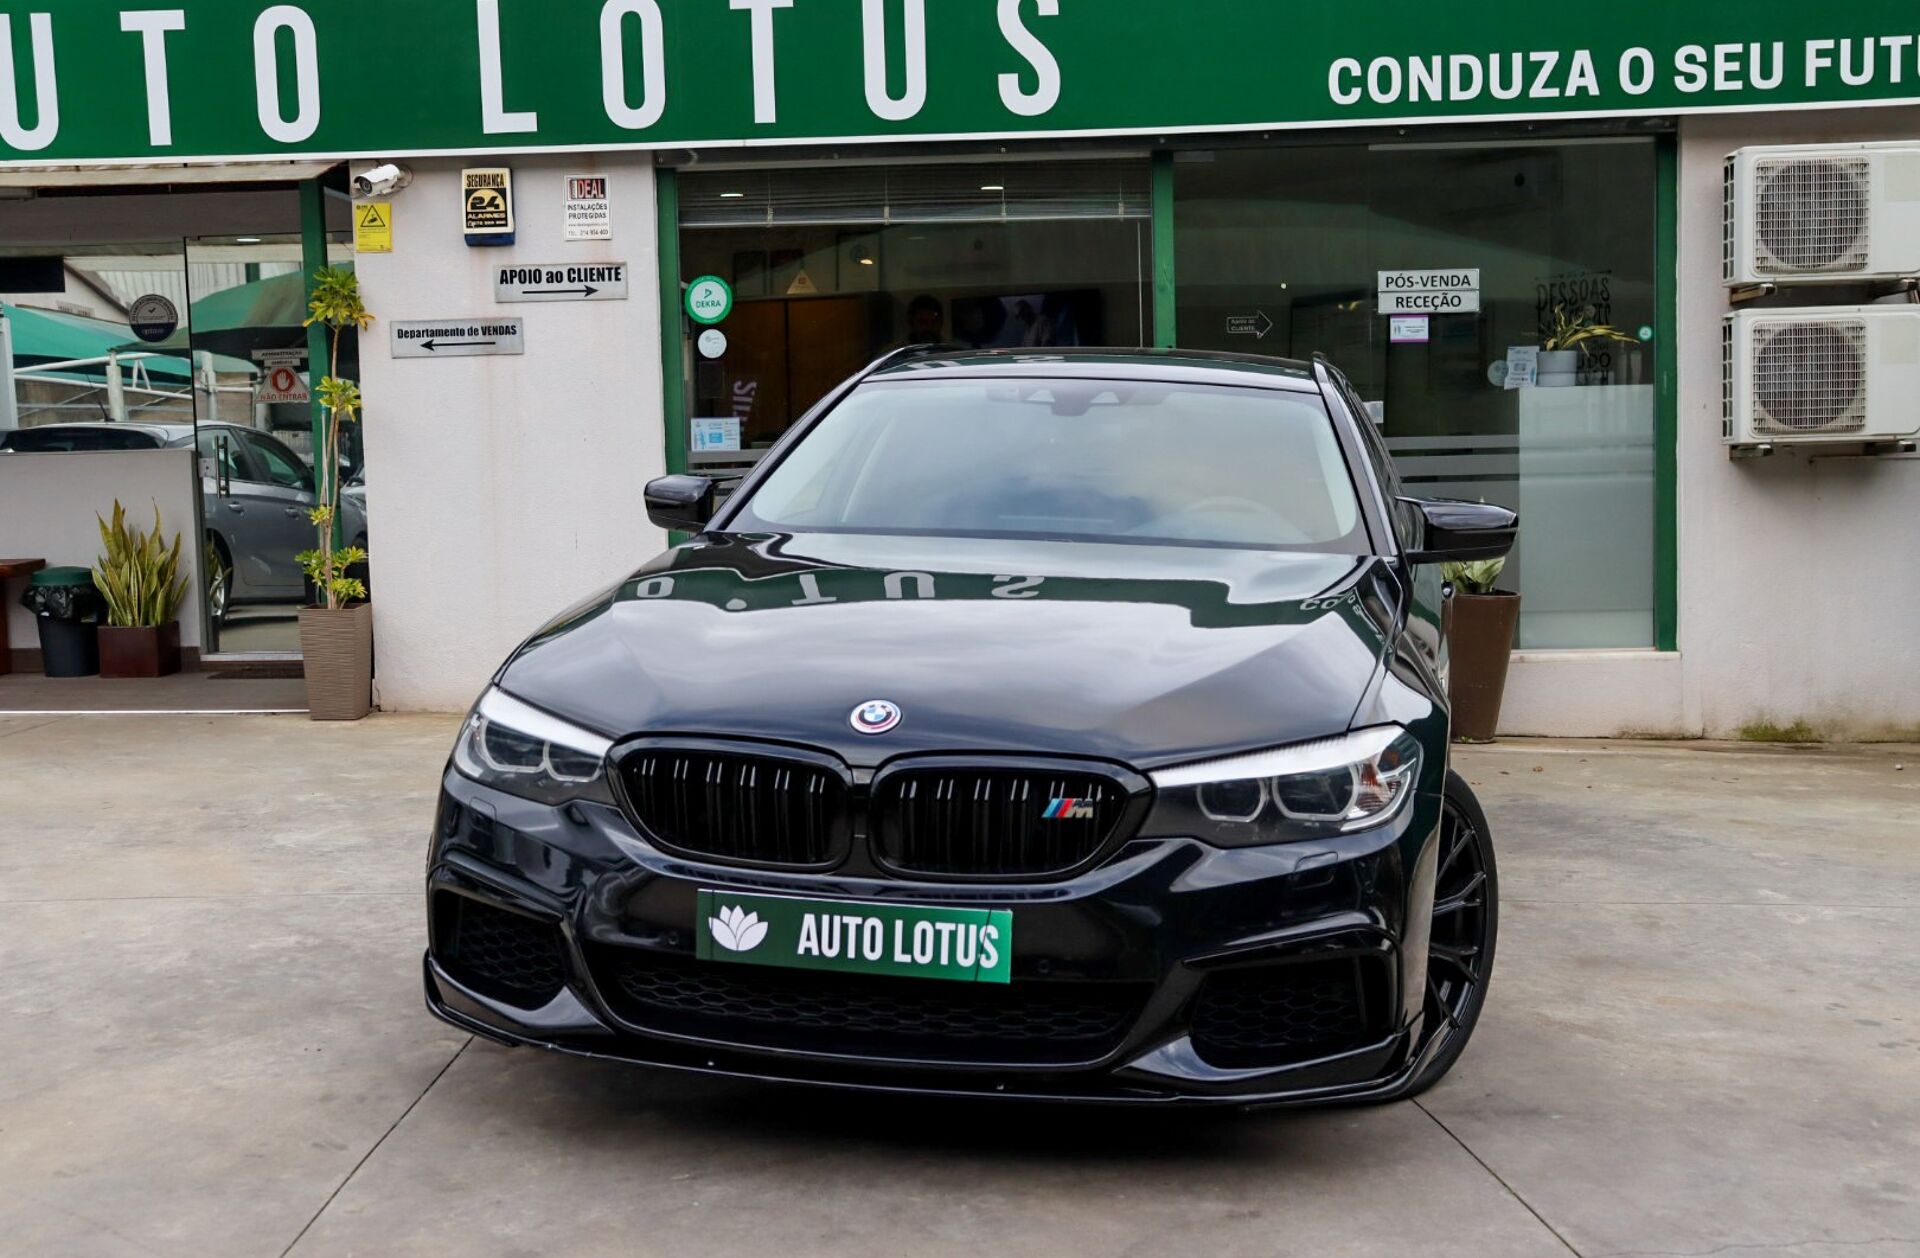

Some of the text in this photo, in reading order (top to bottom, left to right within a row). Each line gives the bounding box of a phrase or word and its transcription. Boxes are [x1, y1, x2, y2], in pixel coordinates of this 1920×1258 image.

[477, 0, 1061, 134] LOTUS
[1328, 35, 1920, 105] CONDUZA O SEU FUT
[467, 174, 504, 188] SEGURANÇA
[471, 196, 499, 210] 24
[568, 202, 607, 211] INSTALAÇÕES
[568, 212, 607, 220] PROTEGIDAS
[499, 266, 622, 285] APOIO ao CLIENTE
[1385, 273, 1471, 289] PÓS-VENDA
[696, 300, 721, 308] DEKRA
[1395, 292, 1462, 310] RECEÇÃO
[397, 325, 517, 340] Departamento de VENDAS
[260, 391, 276, 400] NÃO
[797, 913, 999, 969] AUTO LOTUS
